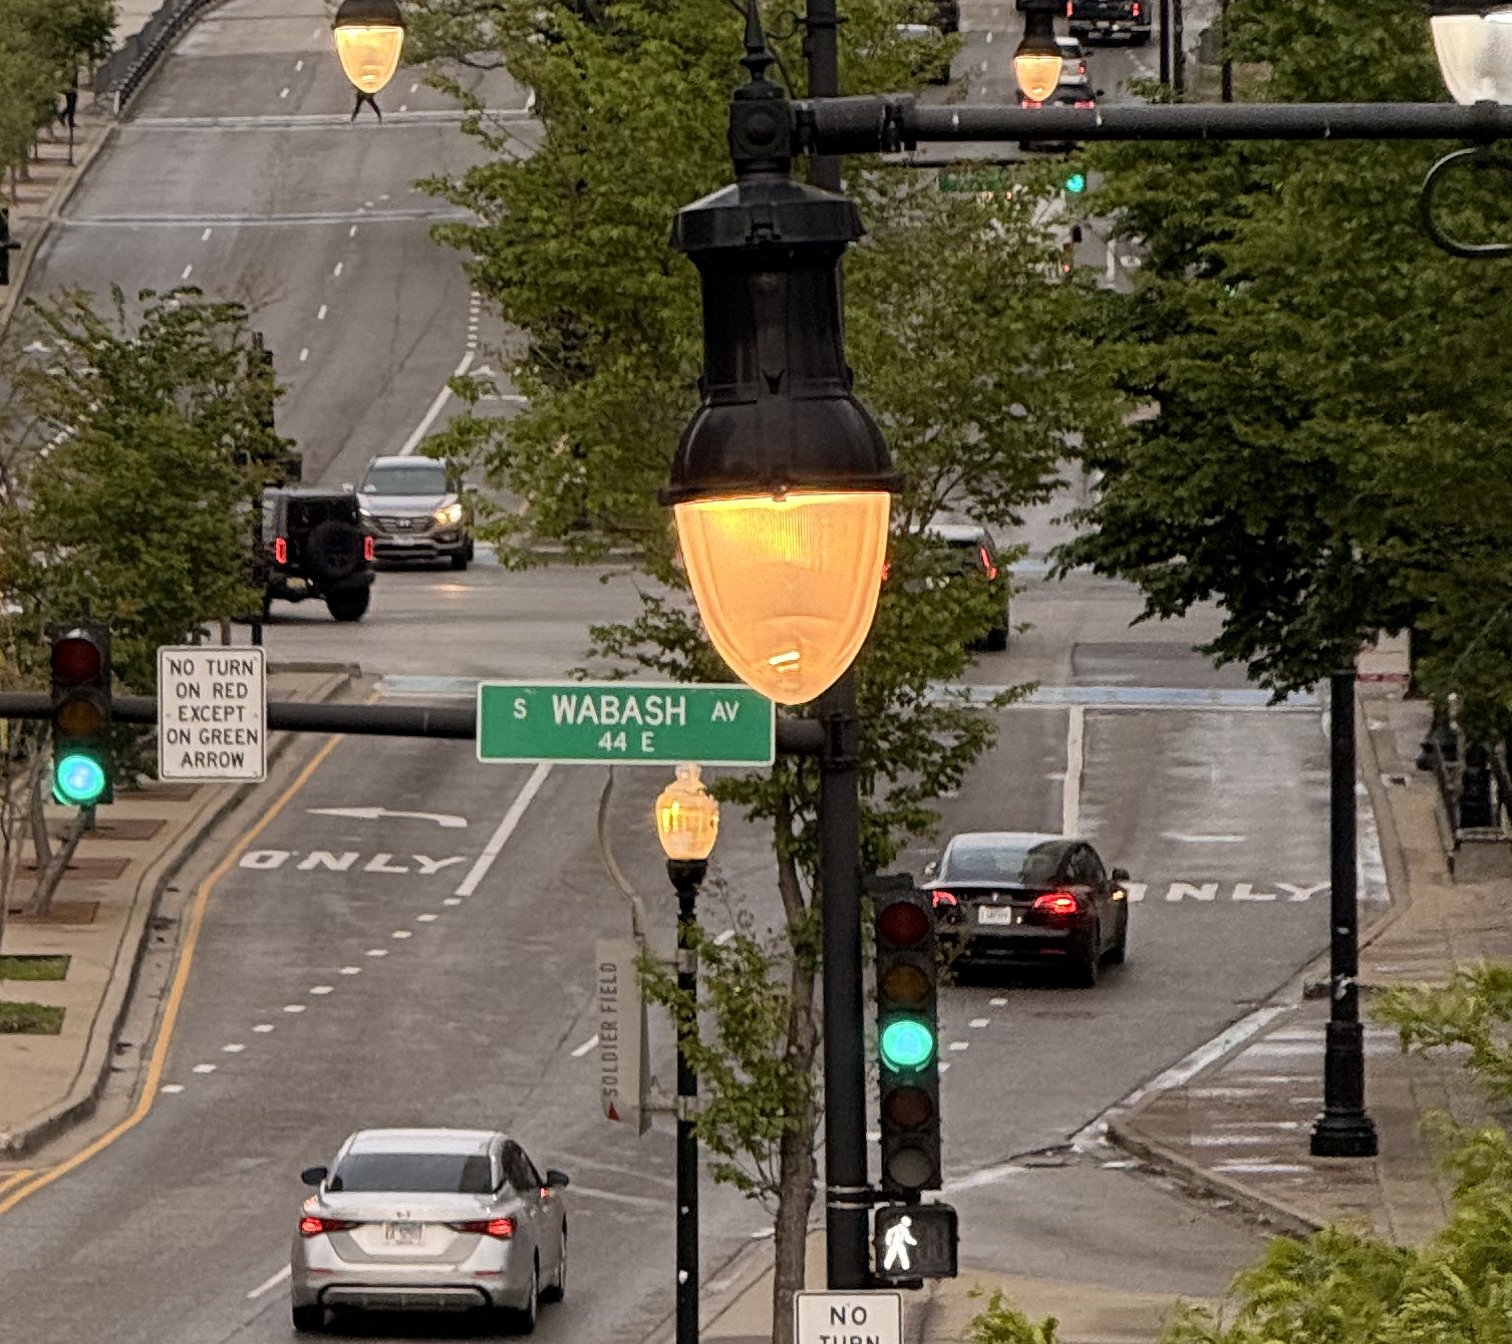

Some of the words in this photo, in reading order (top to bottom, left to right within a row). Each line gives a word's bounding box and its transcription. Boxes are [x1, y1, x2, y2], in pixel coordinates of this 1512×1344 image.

[170, 658, 195, 676] NO
[206, 658, 254, 676] TURN
[176, 682, 201, 699] ON
[212, 682, 249, 699] RED
[178, 705, 246, 722] EXCEPT
[513, 698, 528, 720] S
[552, 694, 686, 726] WABASH
[711, 701, 740, 723] AV
[167, 727, 191, 745] ON
[199, 727, 259, 745] GREEN
[597, 731, 628, 752] 44
[641, 731, 656, 753] E
[181, 751, 245, 769] ARROW
[238, 849, 468, 875] ONLY
[598, 961, 618, 1013] FIELD
[599, 1020, 619, 1098] SOLDIER
[830, 1305, 868, 1326] NO
